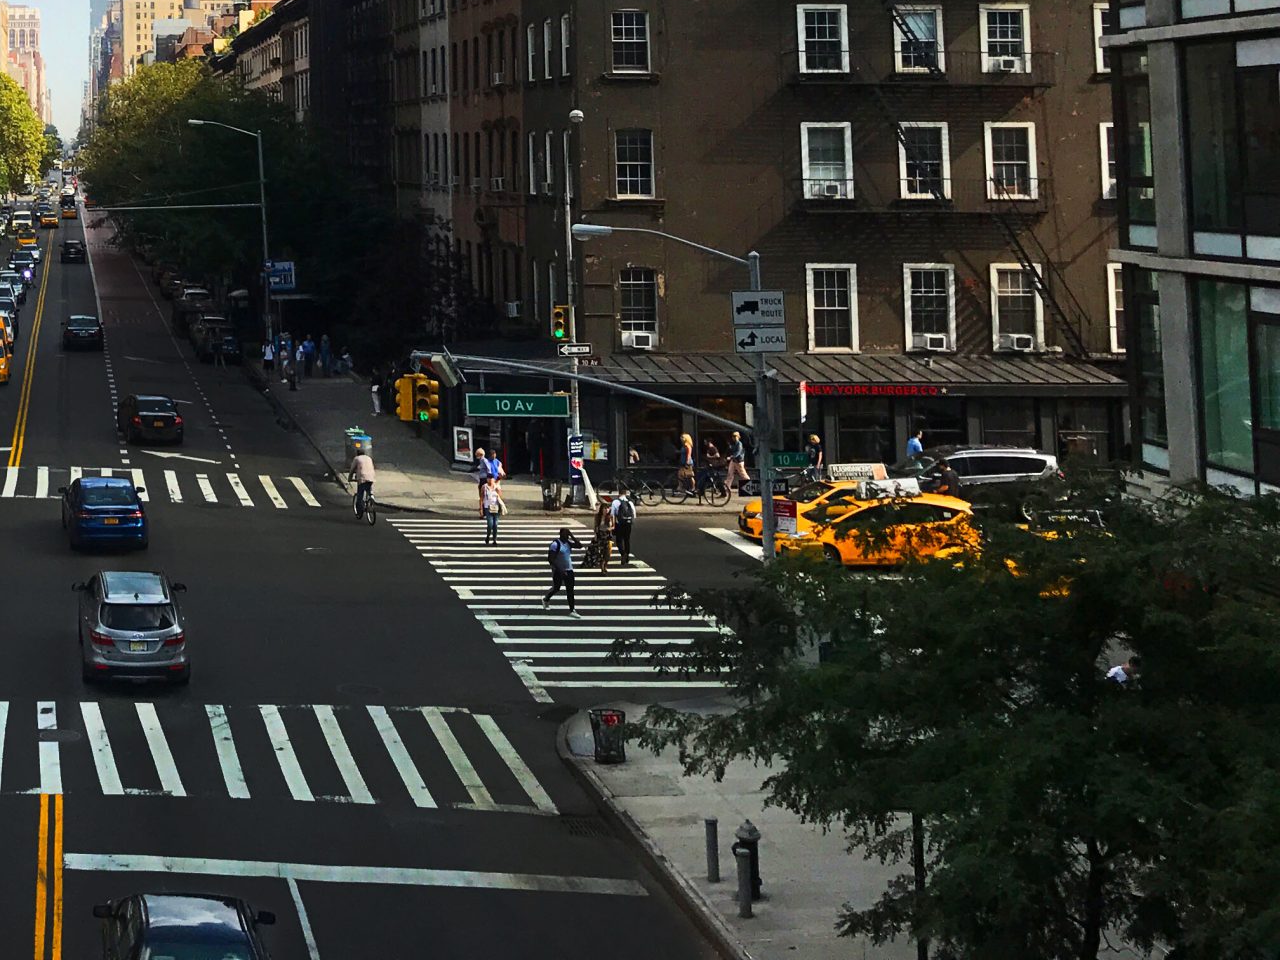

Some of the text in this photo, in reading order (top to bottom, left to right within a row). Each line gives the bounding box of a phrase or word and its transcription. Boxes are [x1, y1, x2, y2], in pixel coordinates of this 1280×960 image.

[760, 336, 786, 344] LOCAL
[805, 385, 938, 396] NEW YORK BURGER CO
[496, 400, 534, 411] 10 Av
[778, 454, 790, 465] 10
